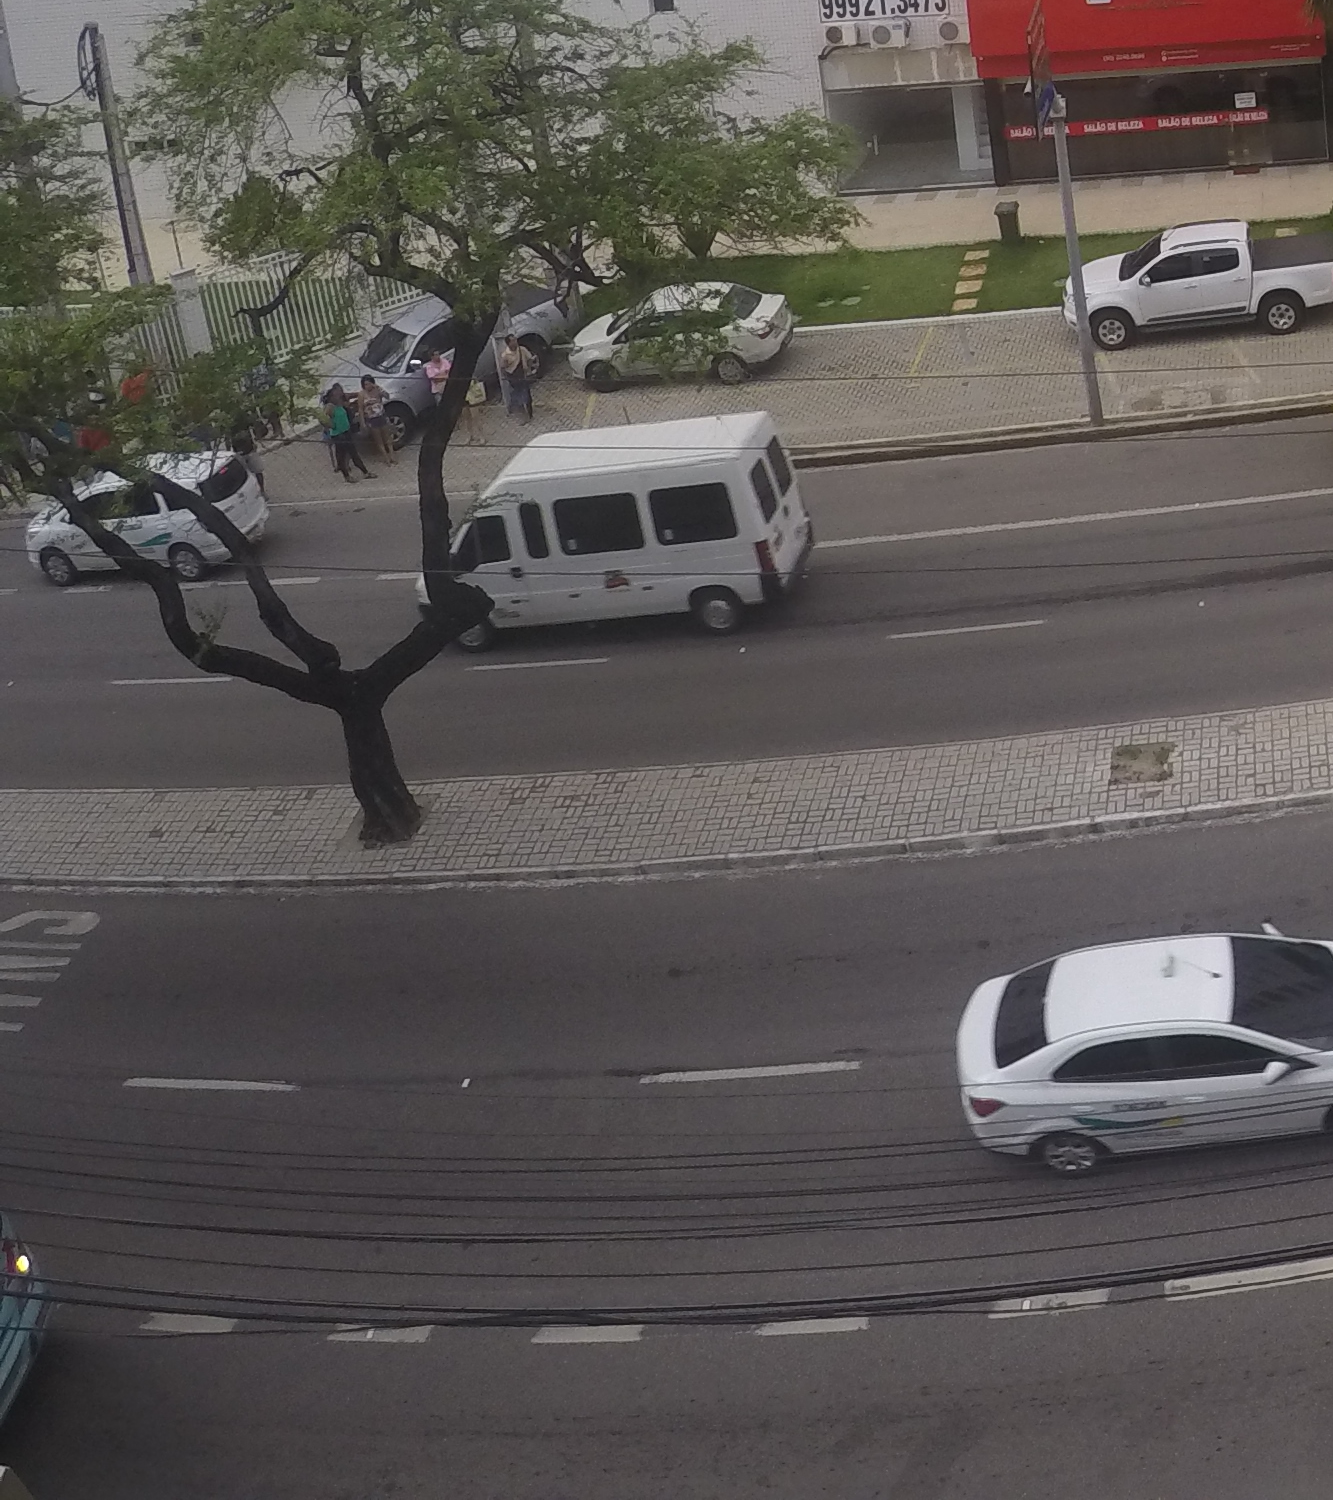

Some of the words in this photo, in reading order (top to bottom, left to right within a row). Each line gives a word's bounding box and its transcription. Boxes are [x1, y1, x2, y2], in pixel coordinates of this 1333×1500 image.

[1083, 120, 1107, 133] SALÃO
[1118, 119, 1144, 131] BELEZA
[1157, 115, 1181, 128] SALÃO
